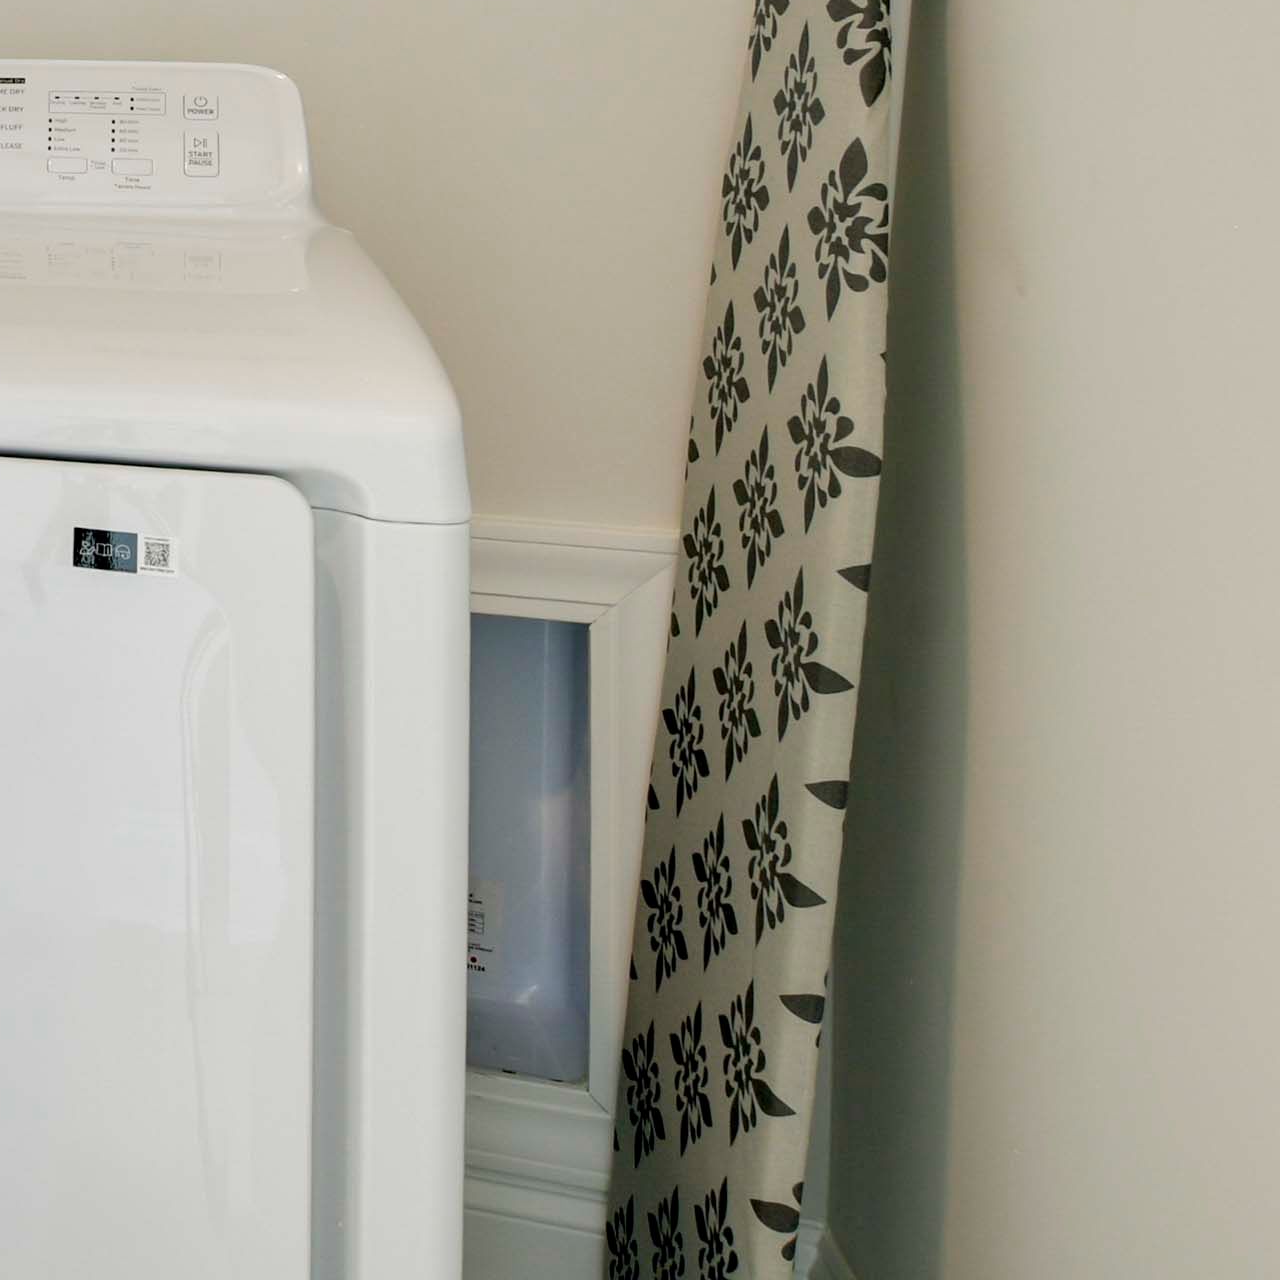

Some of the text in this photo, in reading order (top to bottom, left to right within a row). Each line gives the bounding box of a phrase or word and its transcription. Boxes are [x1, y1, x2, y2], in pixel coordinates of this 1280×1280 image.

[187, 108, 215, 116] POWER
[187, 150, 213, 158] START
[188, 159, 213, 167] PAUSE
